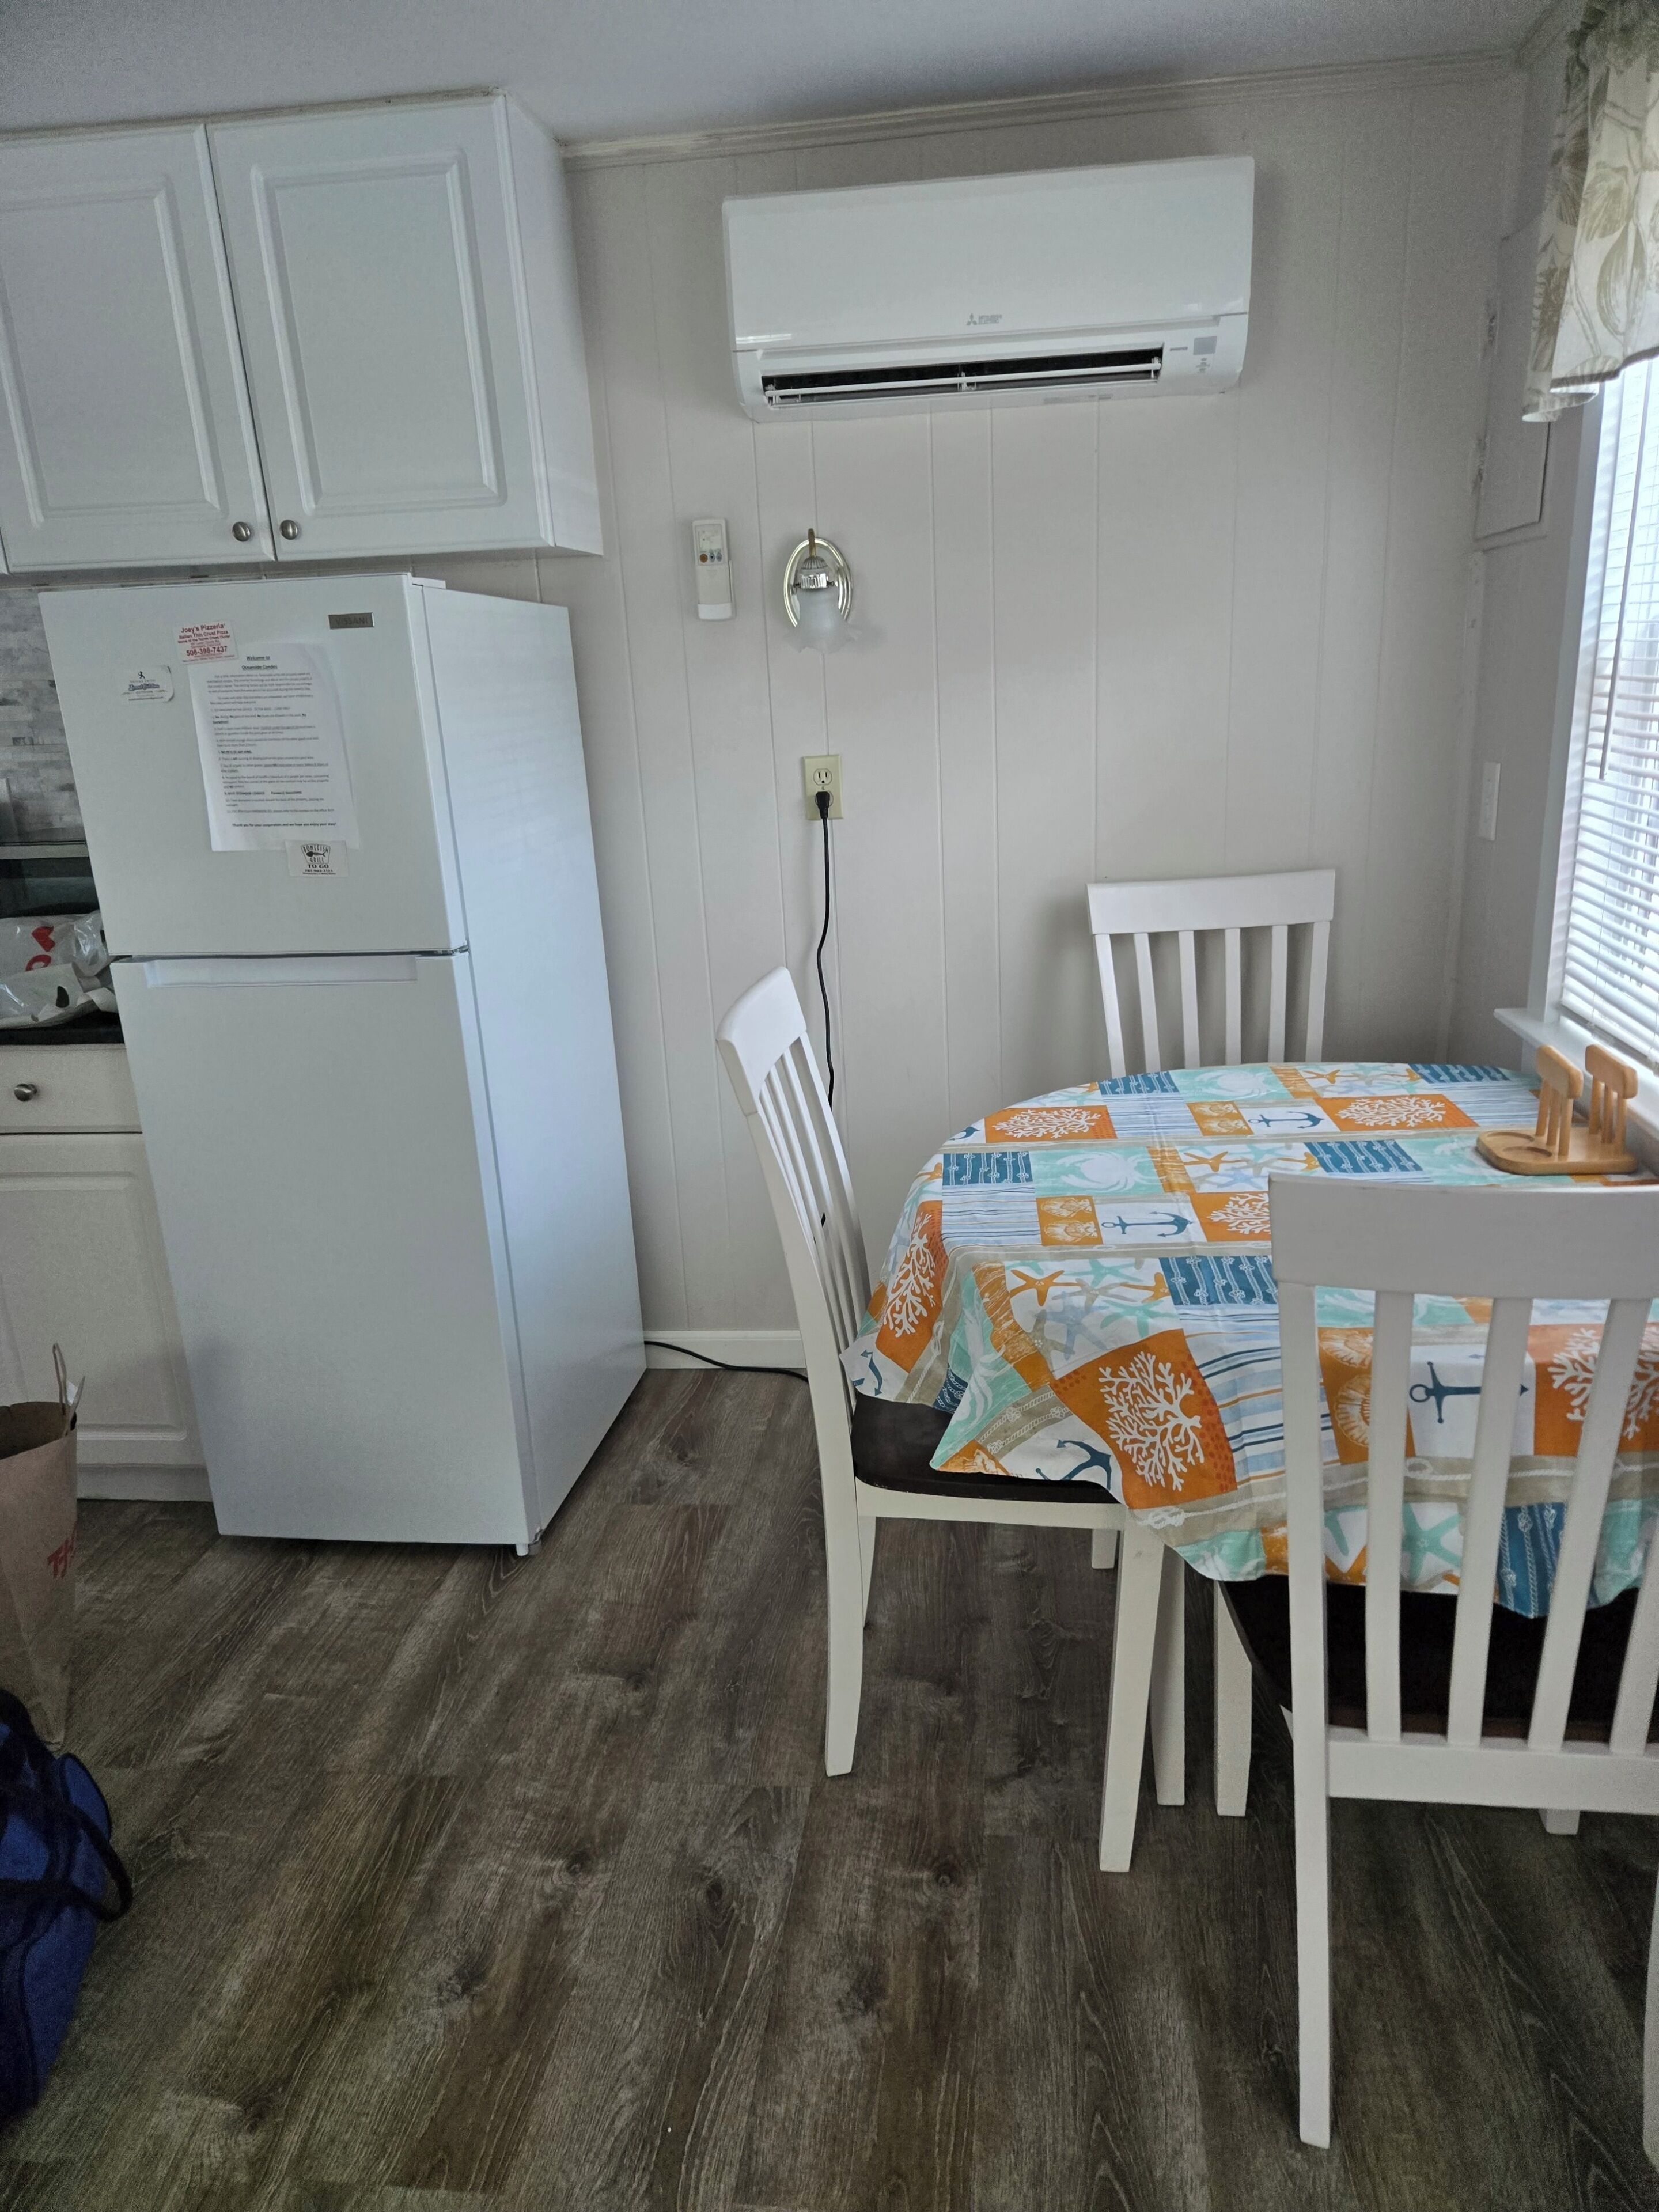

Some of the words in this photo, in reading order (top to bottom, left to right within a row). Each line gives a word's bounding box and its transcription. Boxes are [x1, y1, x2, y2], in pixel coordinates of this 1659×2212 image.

[335, 616, 368, 625] VISSANI
[181, 626, 200, 634] Joey's
[186, 646, 228, 656] 508-398-7437
[303, 845, 329, 853] BONEFISH
